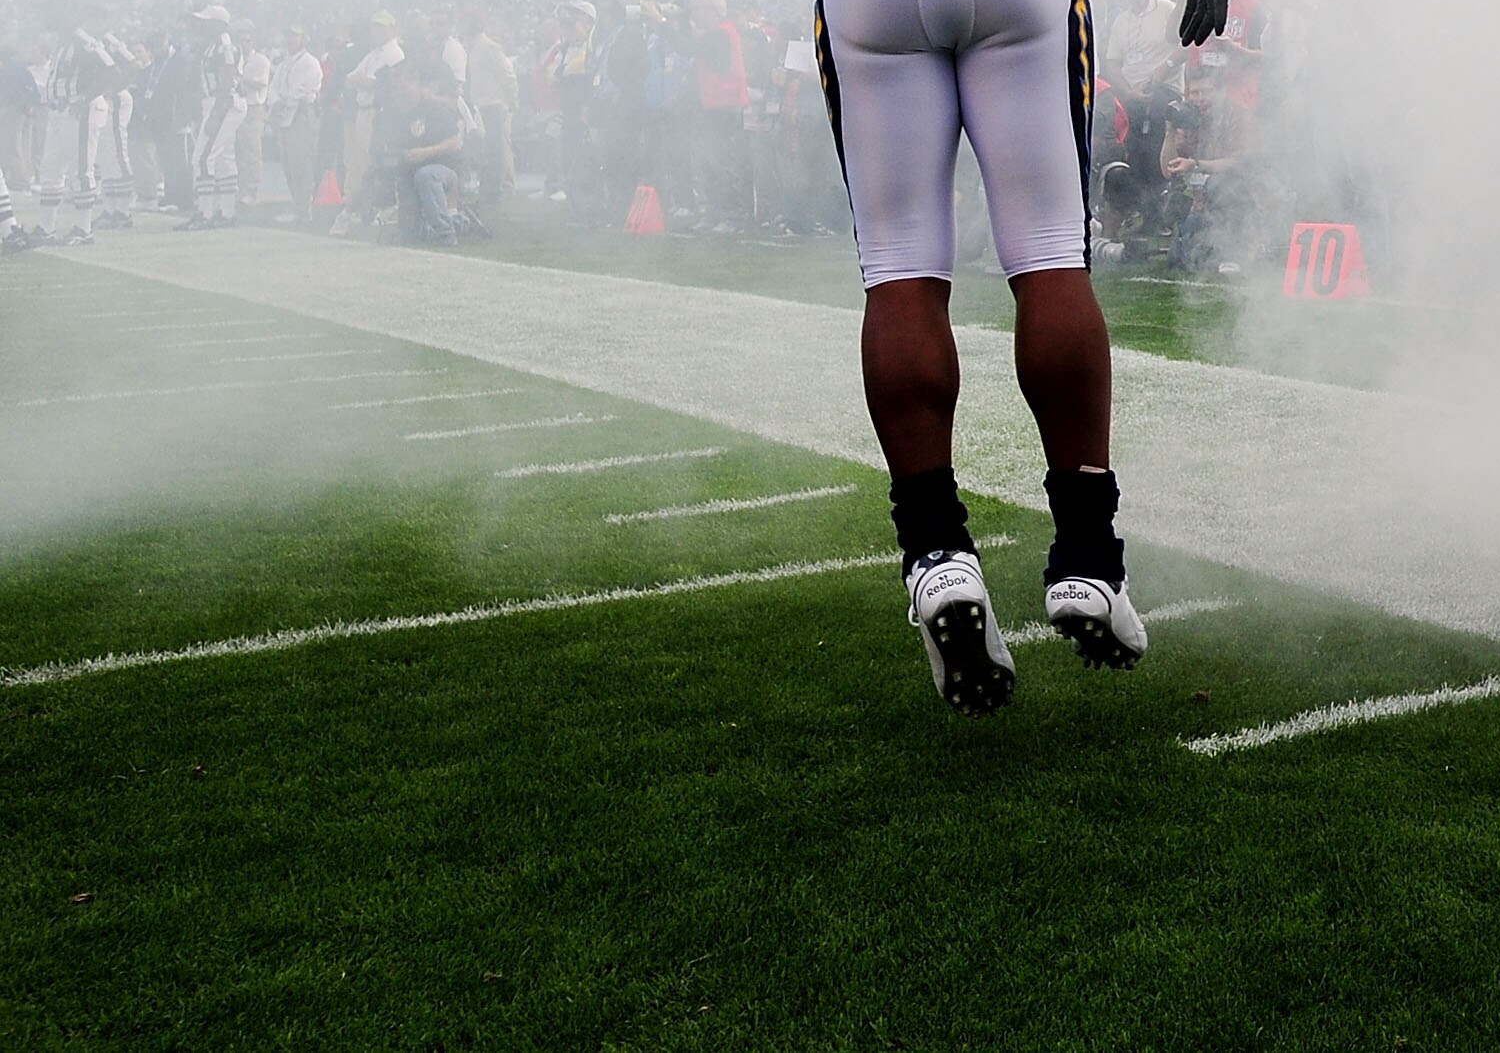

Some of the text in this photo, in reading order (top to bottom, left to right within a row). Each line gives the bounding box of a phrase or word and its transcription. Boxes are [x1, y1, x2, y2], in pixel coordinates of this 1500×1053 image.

[1295, 229, 1345, 295] 10
[926, 575, 968, 599] Reebok
[1050, 590, 1092, 602] Reebok
